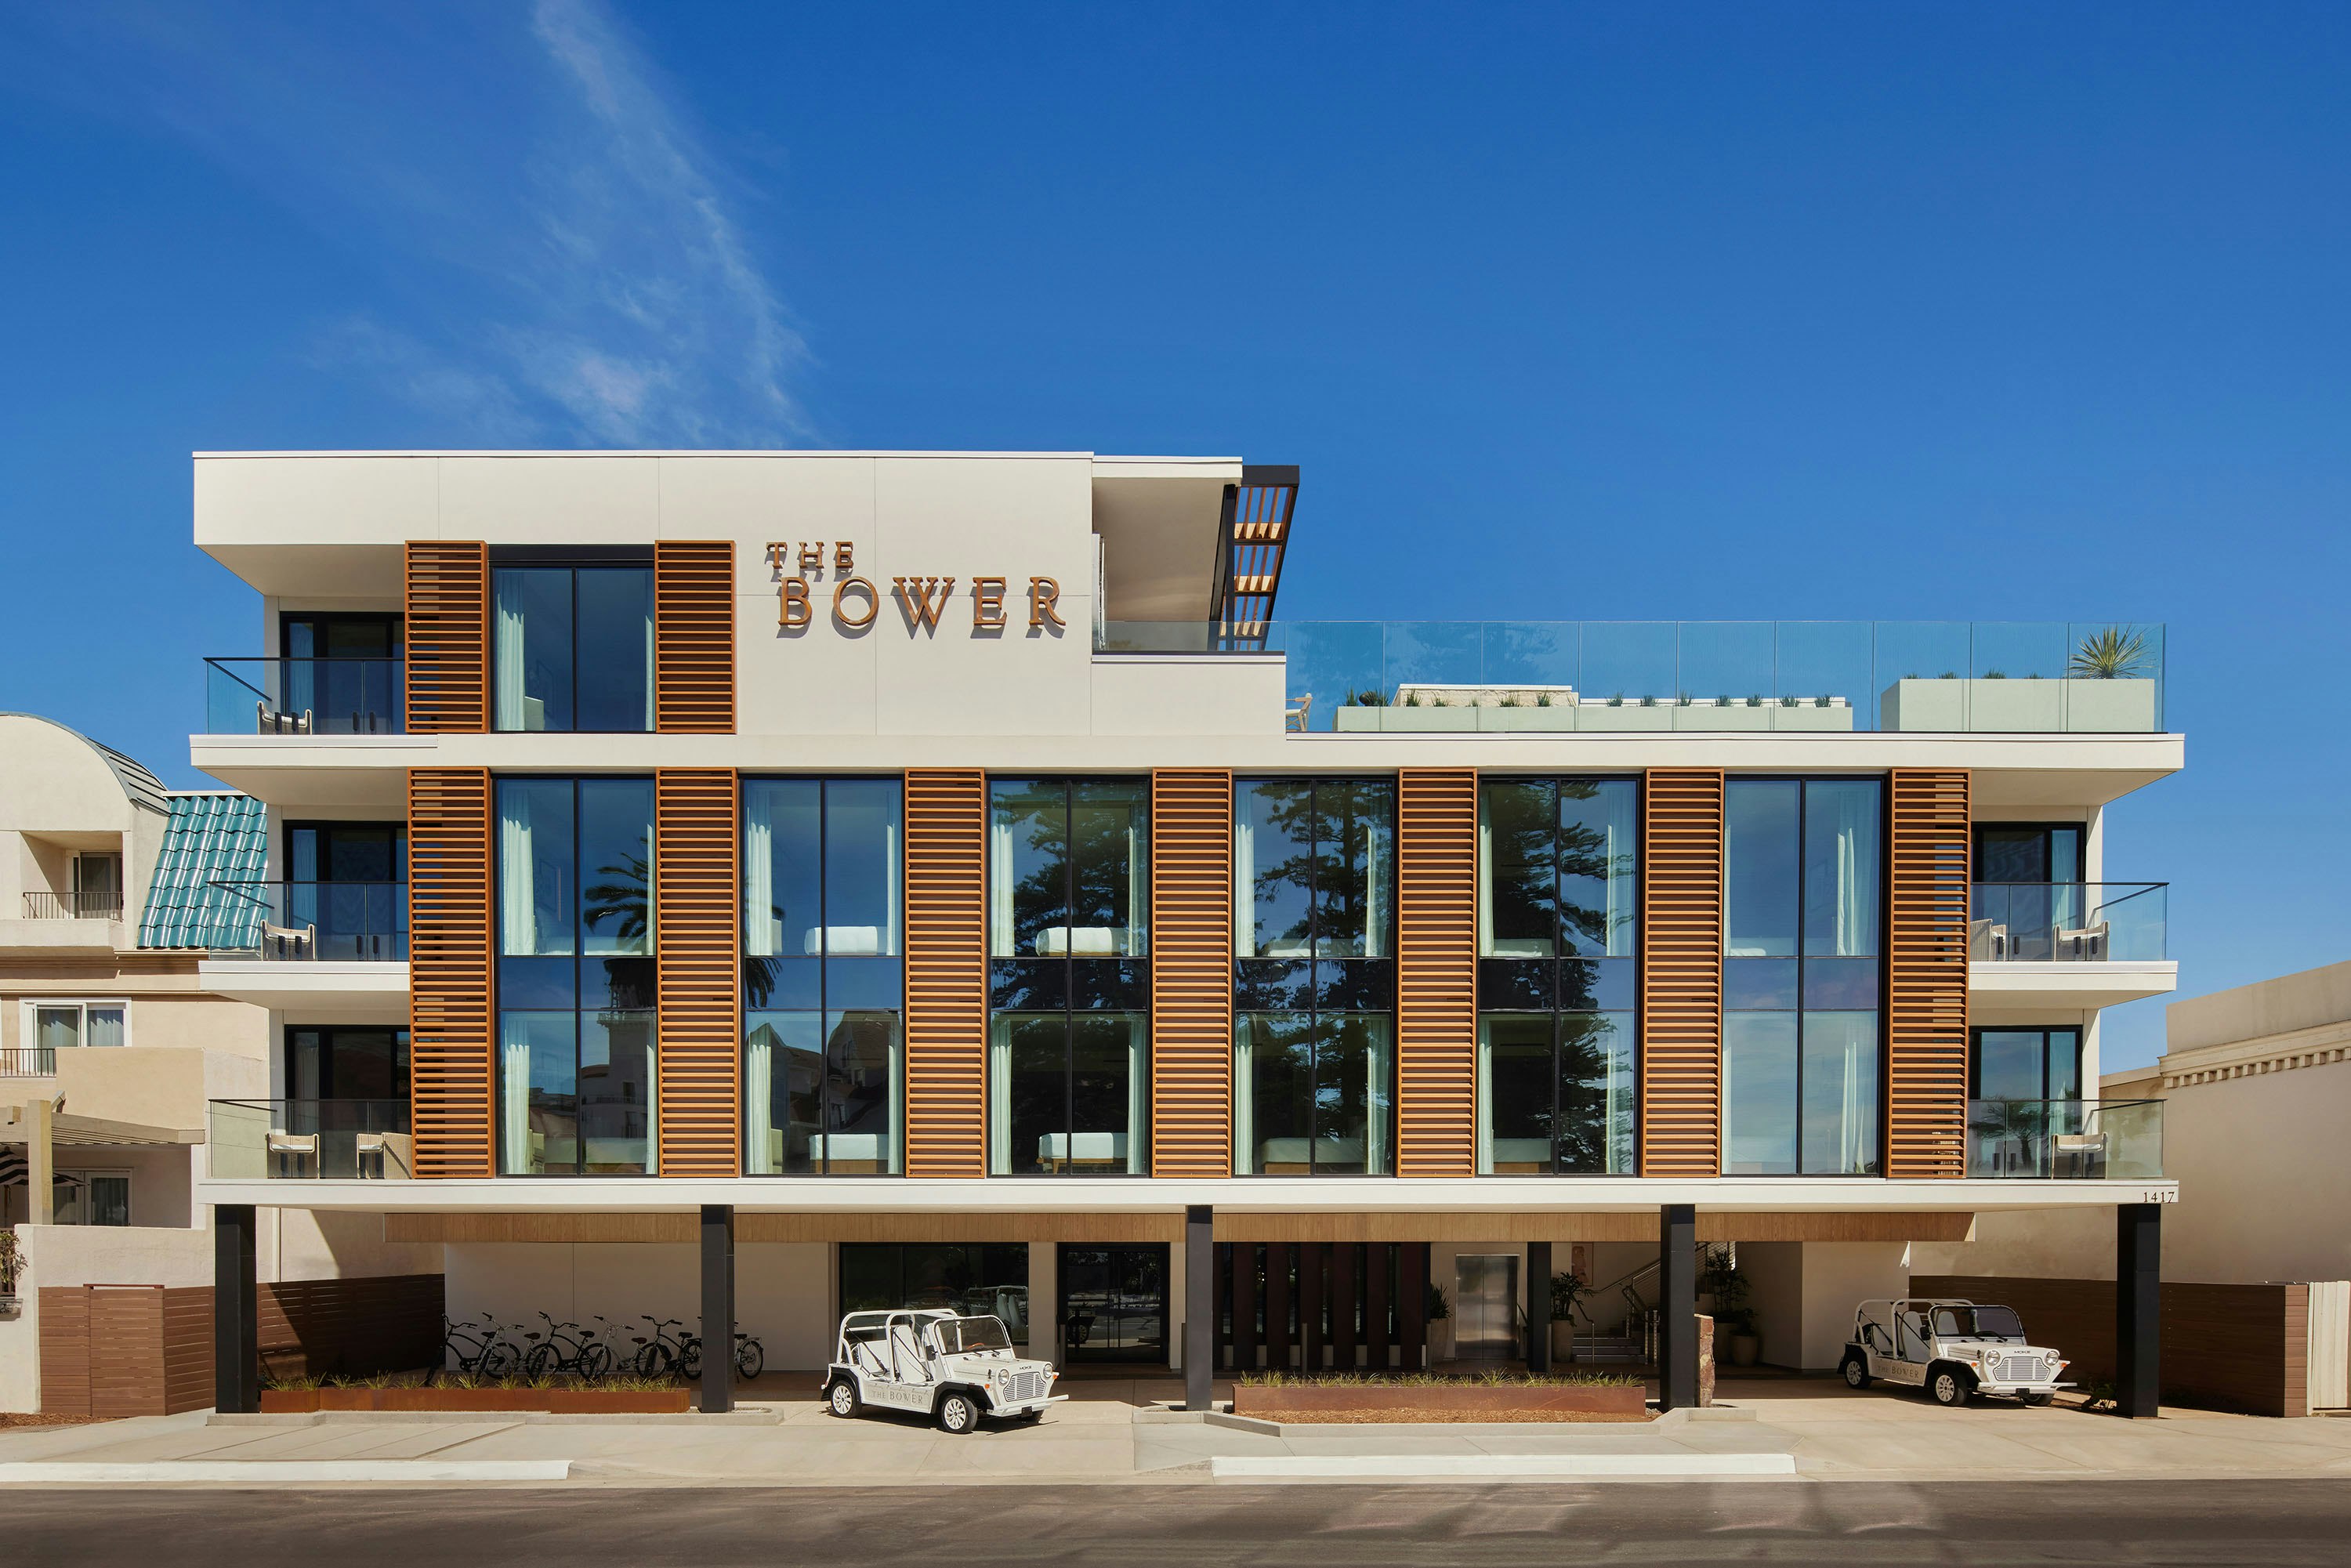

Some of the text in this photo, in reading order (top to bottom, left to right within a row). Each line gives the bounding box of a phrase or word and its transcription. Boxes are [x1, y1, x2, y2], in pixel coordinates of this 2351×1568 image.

[766, 541, 854, 569] THE
[777, 576, 1067, 627] BOWER
[2143, 1191, 2175, 1204] 1417
[872, 1390, 923, 1404] THE BOWER
